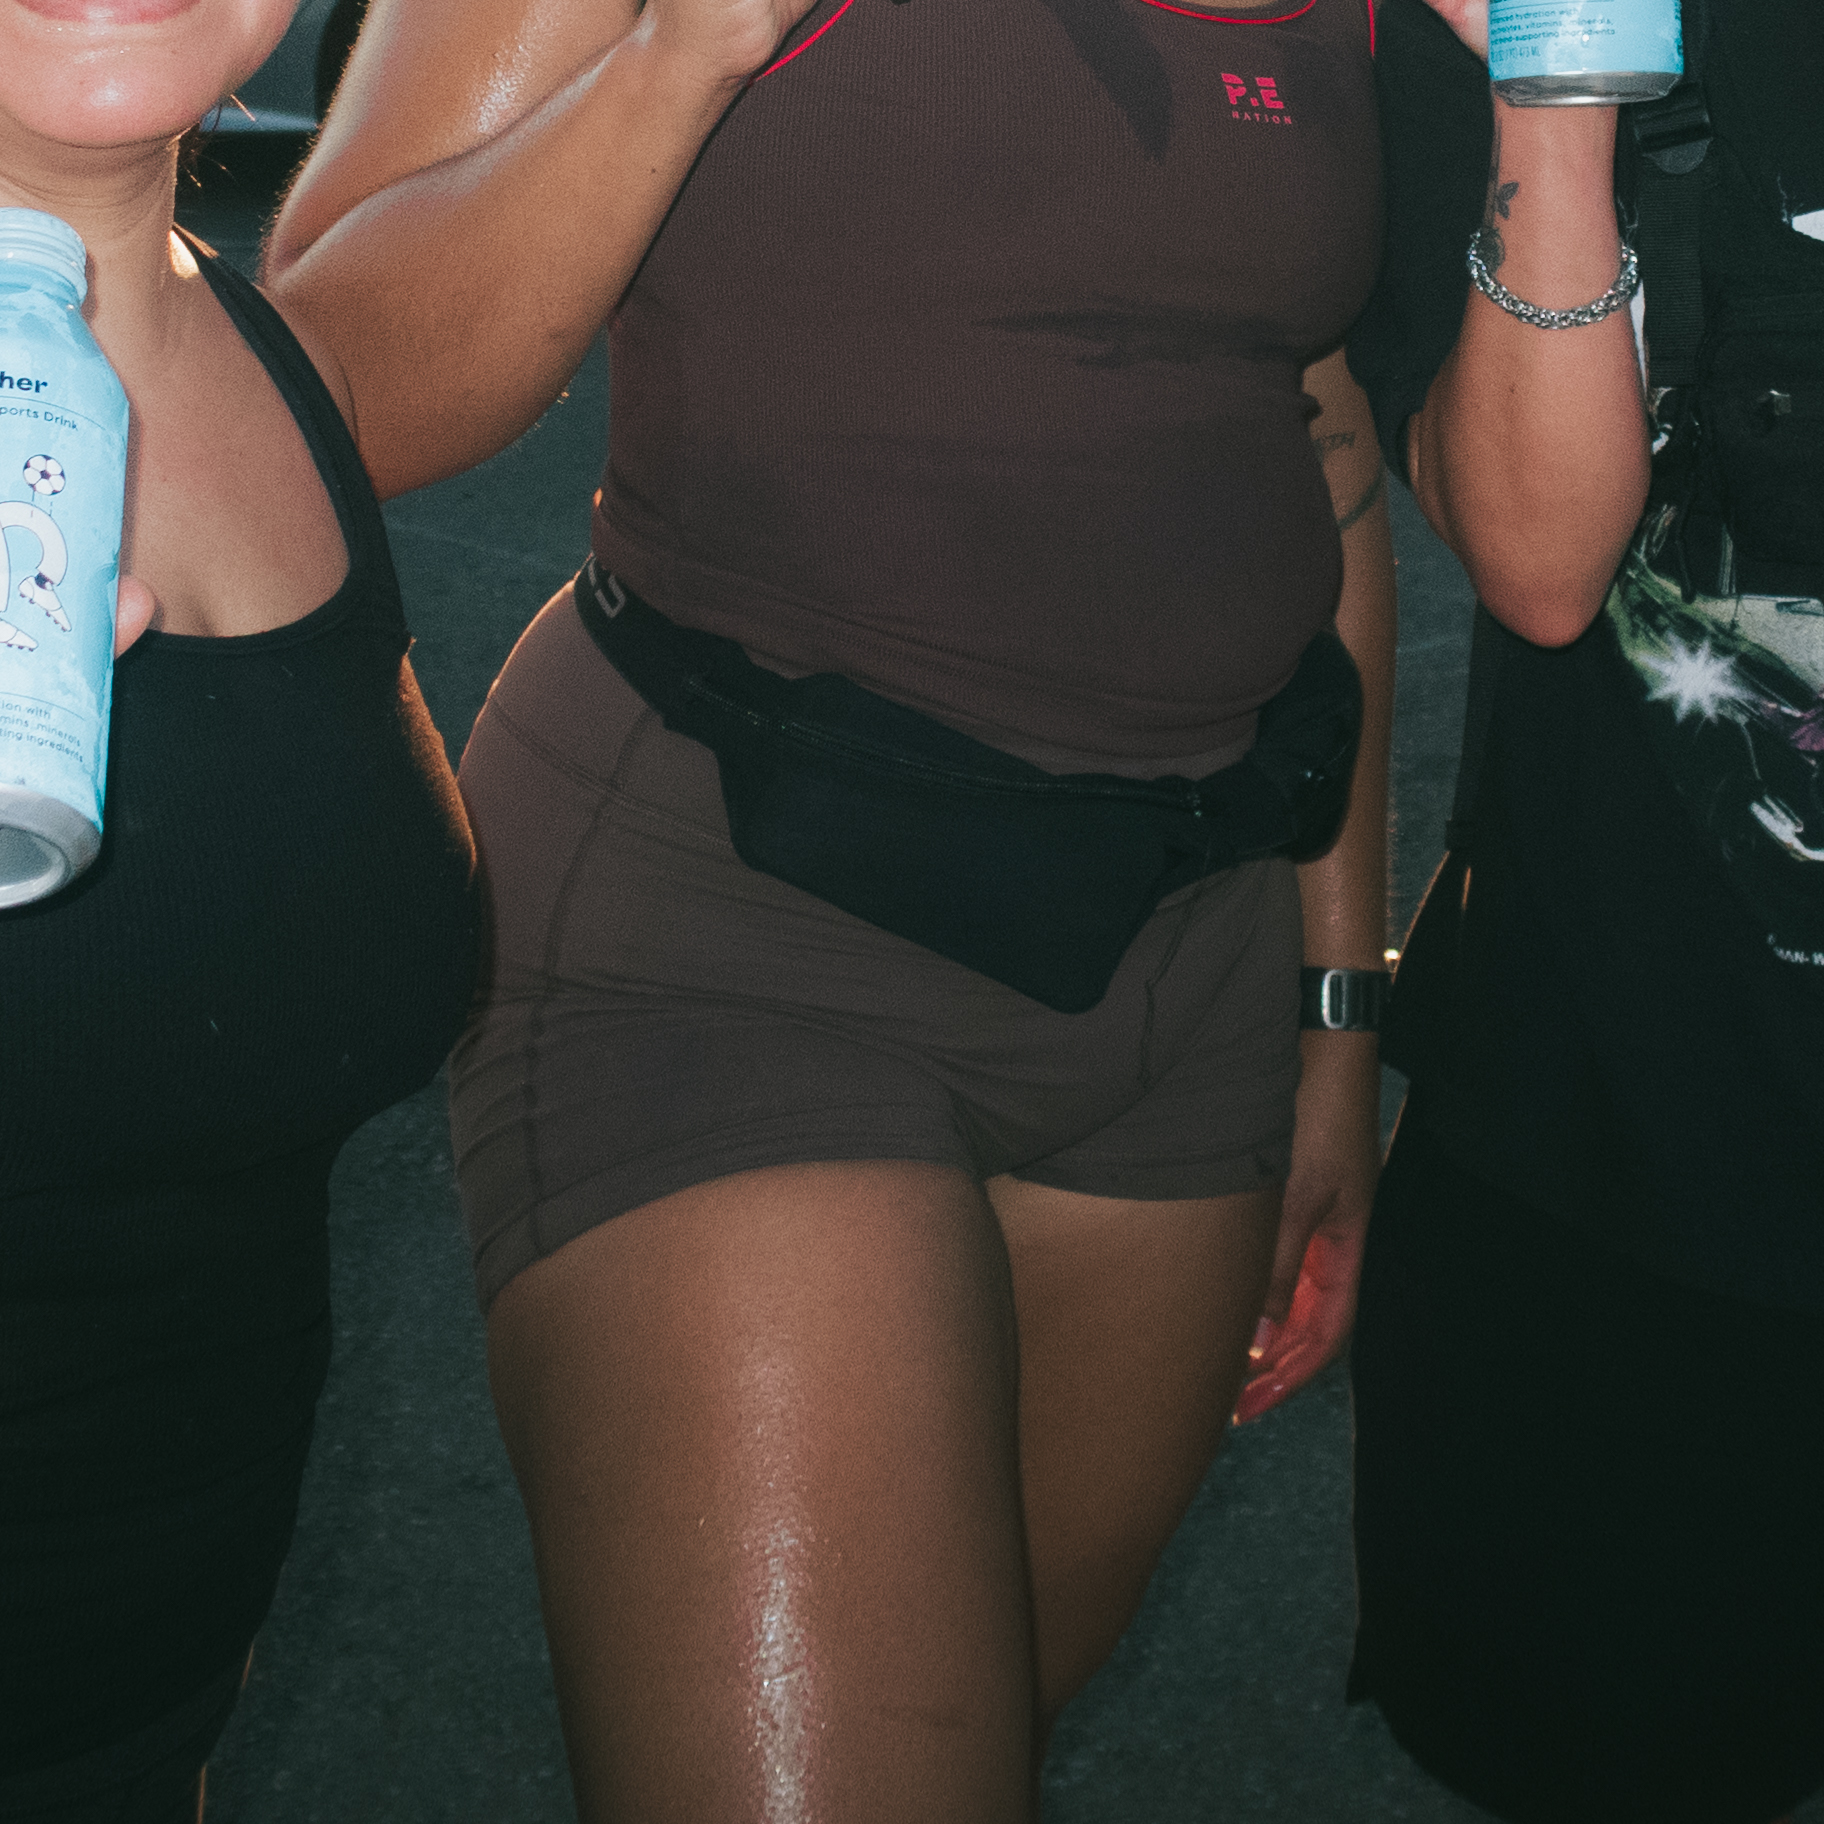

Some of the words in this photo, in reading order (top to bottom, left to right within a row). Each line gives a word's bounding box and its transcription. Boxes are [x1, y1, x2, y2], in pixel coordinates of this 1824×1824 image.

[1232, 110, 1292, 125] NATION
[43, 411, 78, 431] Drink
[26, 706, 51, 720] with
[26, 734, 83, 763] ingredients
